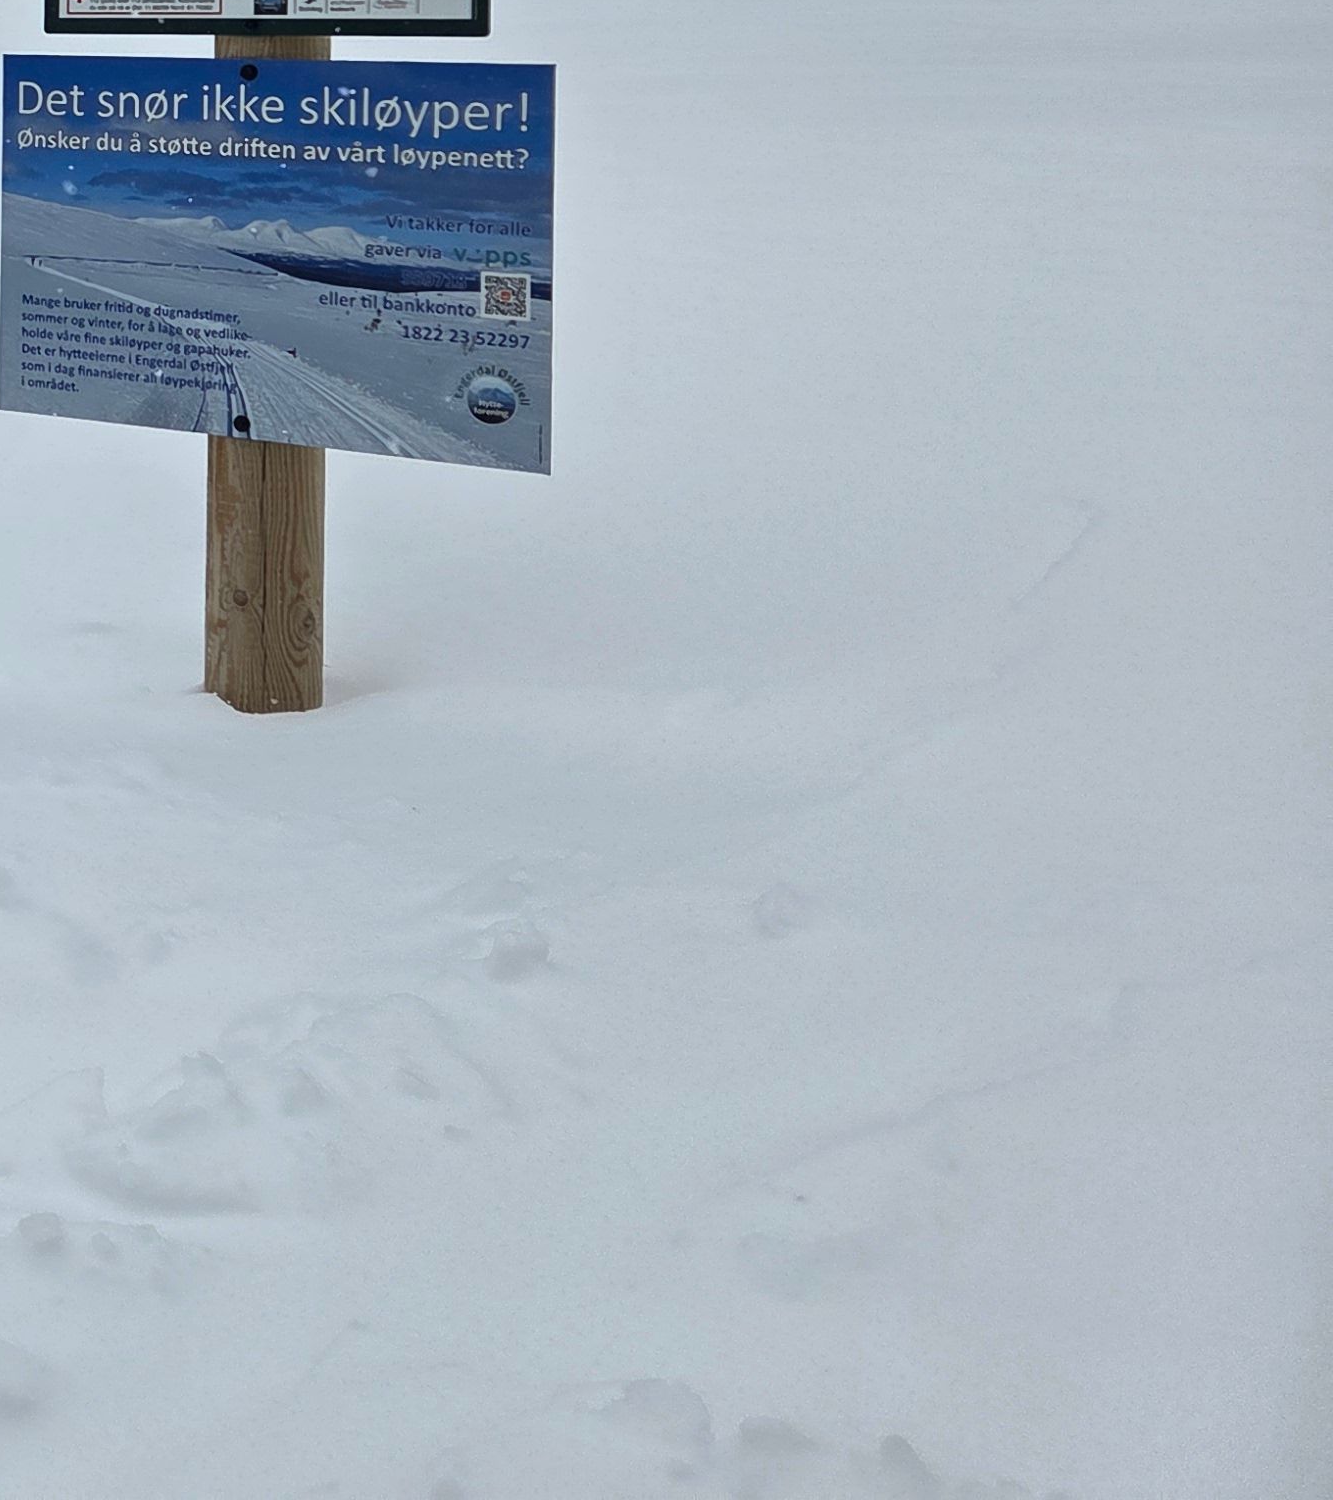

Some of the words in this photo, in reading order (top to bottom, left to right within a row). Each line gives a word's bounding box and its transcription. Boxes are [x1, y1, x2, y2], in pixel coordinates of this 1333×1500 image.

[18, 81, 85, 117] Det
[97, 89, 188, 122] snør
[202, 83, 285, 123] ikke
[299, 86, 529, 139] skiløyper!
[17, 127, 90, 150] Ønsker
[96, 131, 122, 151] du
[130, 132, 141, 153] å
[148, 136, 212, 156] støtte
[219, 136, 296, 159] driften
[303, 144, 331, 161] av
[337, 141, 386, 164] vårt
[393, 143, 530, 169] løypenett?
[385, 214, 403, 229] Vi
[408, 216, 462, 233] takker
[468, 219, 493, 235] for
[499, 220, 532, 237] alle
[364, 243, 411, 259] gaver
[417, 244, 442, 260] via
[22, 293, 61, 309] Mange
[64, 294, 102, 312] bruker
[104, 298, 133, 314] fritid
[136, 304, 151, 317] og
[153, 303, 241, 326] dugnadstimer,
[318, 291, 356, 307] eller
[361, 293, 378, 310] til
[383, 295, 477, 318] bankkonto
[22, 312, 68, 325] sommer
[71, 315, 85, 328] og
[88, 315, 126, 332] vinter,
[127, 319, 145, 333] for
[148, 318, 156, 333] å
[158, 323, 183, 338] lage
[185, 326, 201, 339] og
[203, 327, 253, 342] vedlike-
[402, 325, 443, 342] 1822
[449, 328, 470, 345] 23
[475, 330, 530, 350] 52297
[22, 327, 54, 341] holde
[56, 329, 82, 344] våre
[84, 332, 106, 345] fine
[109, 334, 163, 354] skiløyper
[166, 343, 181, 356] og
[183, 344, 251, 360] gapahuker.
[22, 343, 42, 356] Det
[45, 347, 56, 357] er
[59, 345, 125, 364] hytteeierne
[135, 354, 187, 370] Engerdal
[21, 362, 45, 373] som
[54, 362, 75, 377] dag
[78, 364, 140, 384] finansierer
[28, 378, 79, 393] området.
[453, 365, 496, 399] Engerdal
